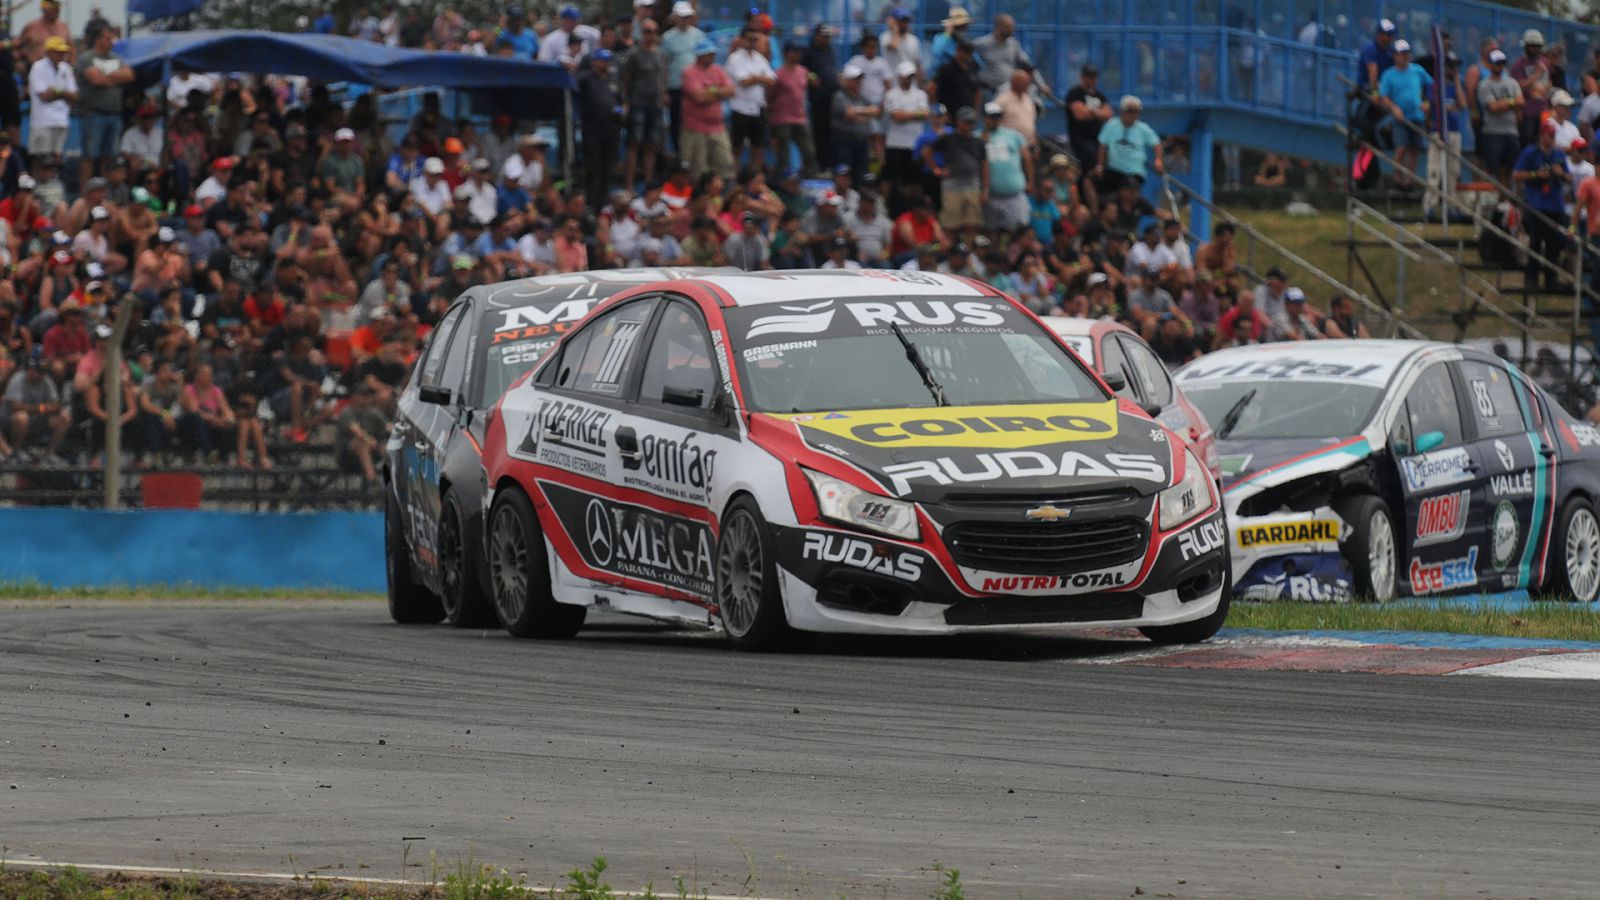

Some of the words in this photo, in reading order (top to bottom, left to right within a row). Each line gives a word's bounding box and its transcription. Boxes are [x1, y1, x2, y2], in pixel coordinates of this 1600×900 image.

[844, 300, 1005, 327] RUS
[866, 328, 889, 336] RIO
[892, 325, 952, 335] RUGUAY
[955, 326, 1015, 334] SEGUROS
[503, 352, 539, 365] C3
[594, 323, 641, 383] 111
[743, 339, 817, 358] GASSMANN
[1473, 380, 1495, 417] 83
[850, 415, 1113, 443] COIRO
[541, 448, 571, 468] PRODUCTOS
[882, 451, 1166, 497] RUDAS
[1490, 470, 1533, 496] VALLÉ
[665, 487, 679, 496] PARA
[1416, 493, 1460, 537] OMBU
[611, 507, 716, 582] MEGA
[1240, 522, 1337, 546] BARDAHL
[617, 560, 657, 579] PARANA
[802, 532, 925, 582] RUDAS
[982, 572, 1126, 591] NUTRITOTAL
